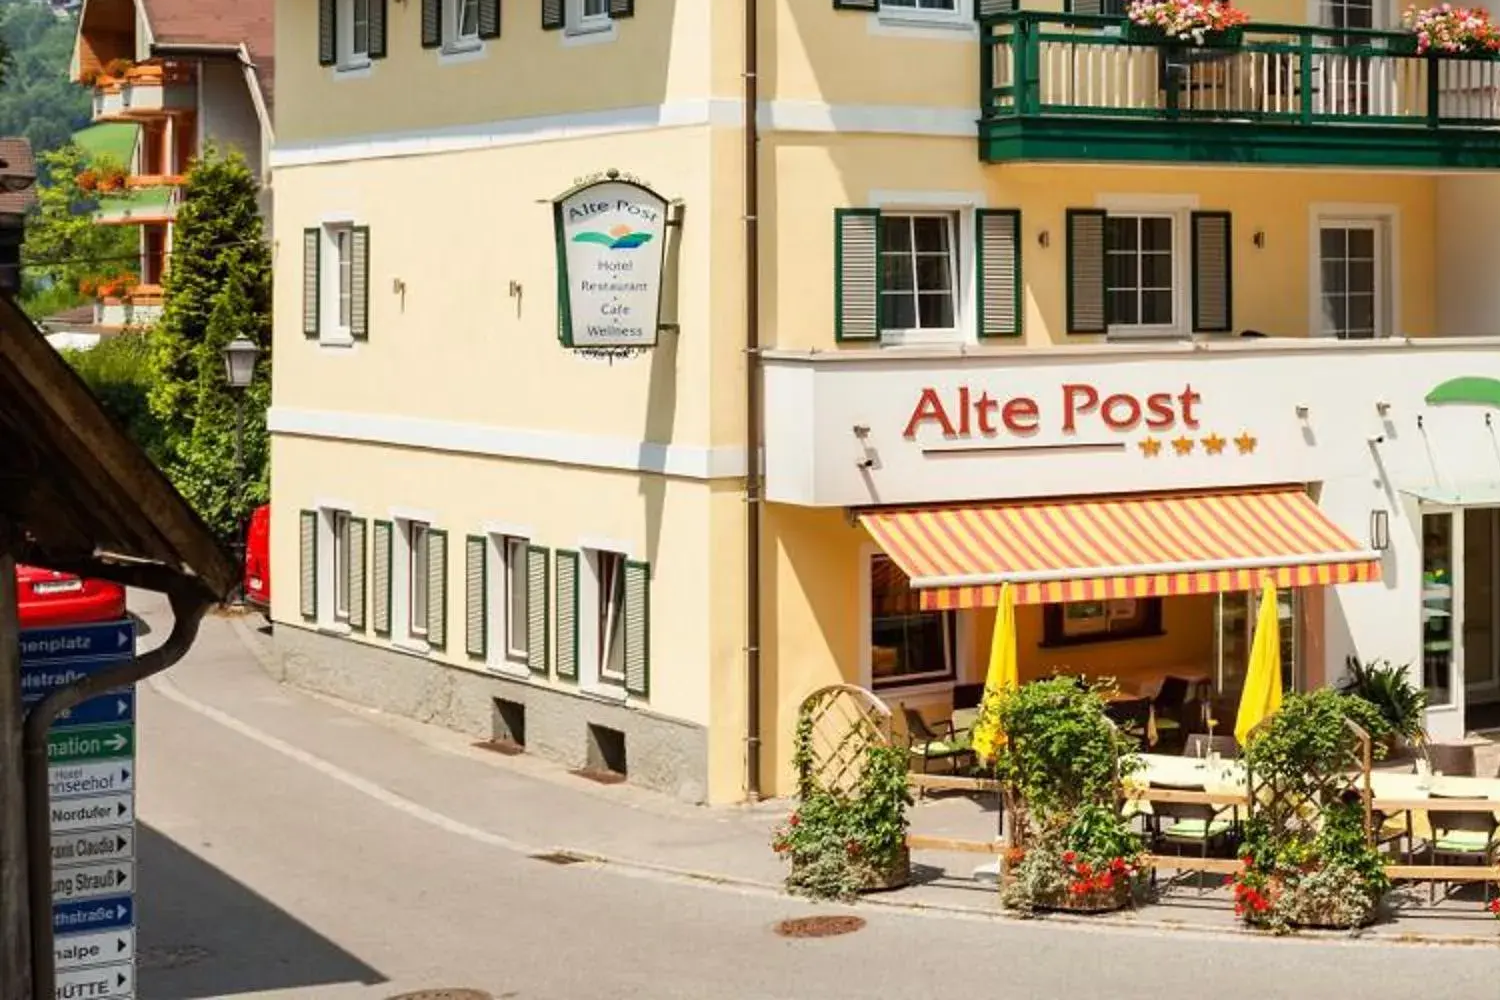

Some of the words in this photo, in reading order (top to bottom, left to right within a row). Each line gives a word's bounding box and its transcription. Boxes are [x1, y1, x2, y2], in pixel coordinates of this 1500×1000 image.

[569, 200, 609, 221] Alte
[616, 200, 659, 222] Post
[597, 259, 634, 272] Hotel
[581, 280, 648, 292] Restaurant
[587, 324, 643, 338] Wellness
[903, 386, 1040, 439] Alte
[1061, 383, 1202, 435] Post
[52, 805, 112, 822] Nordufer
